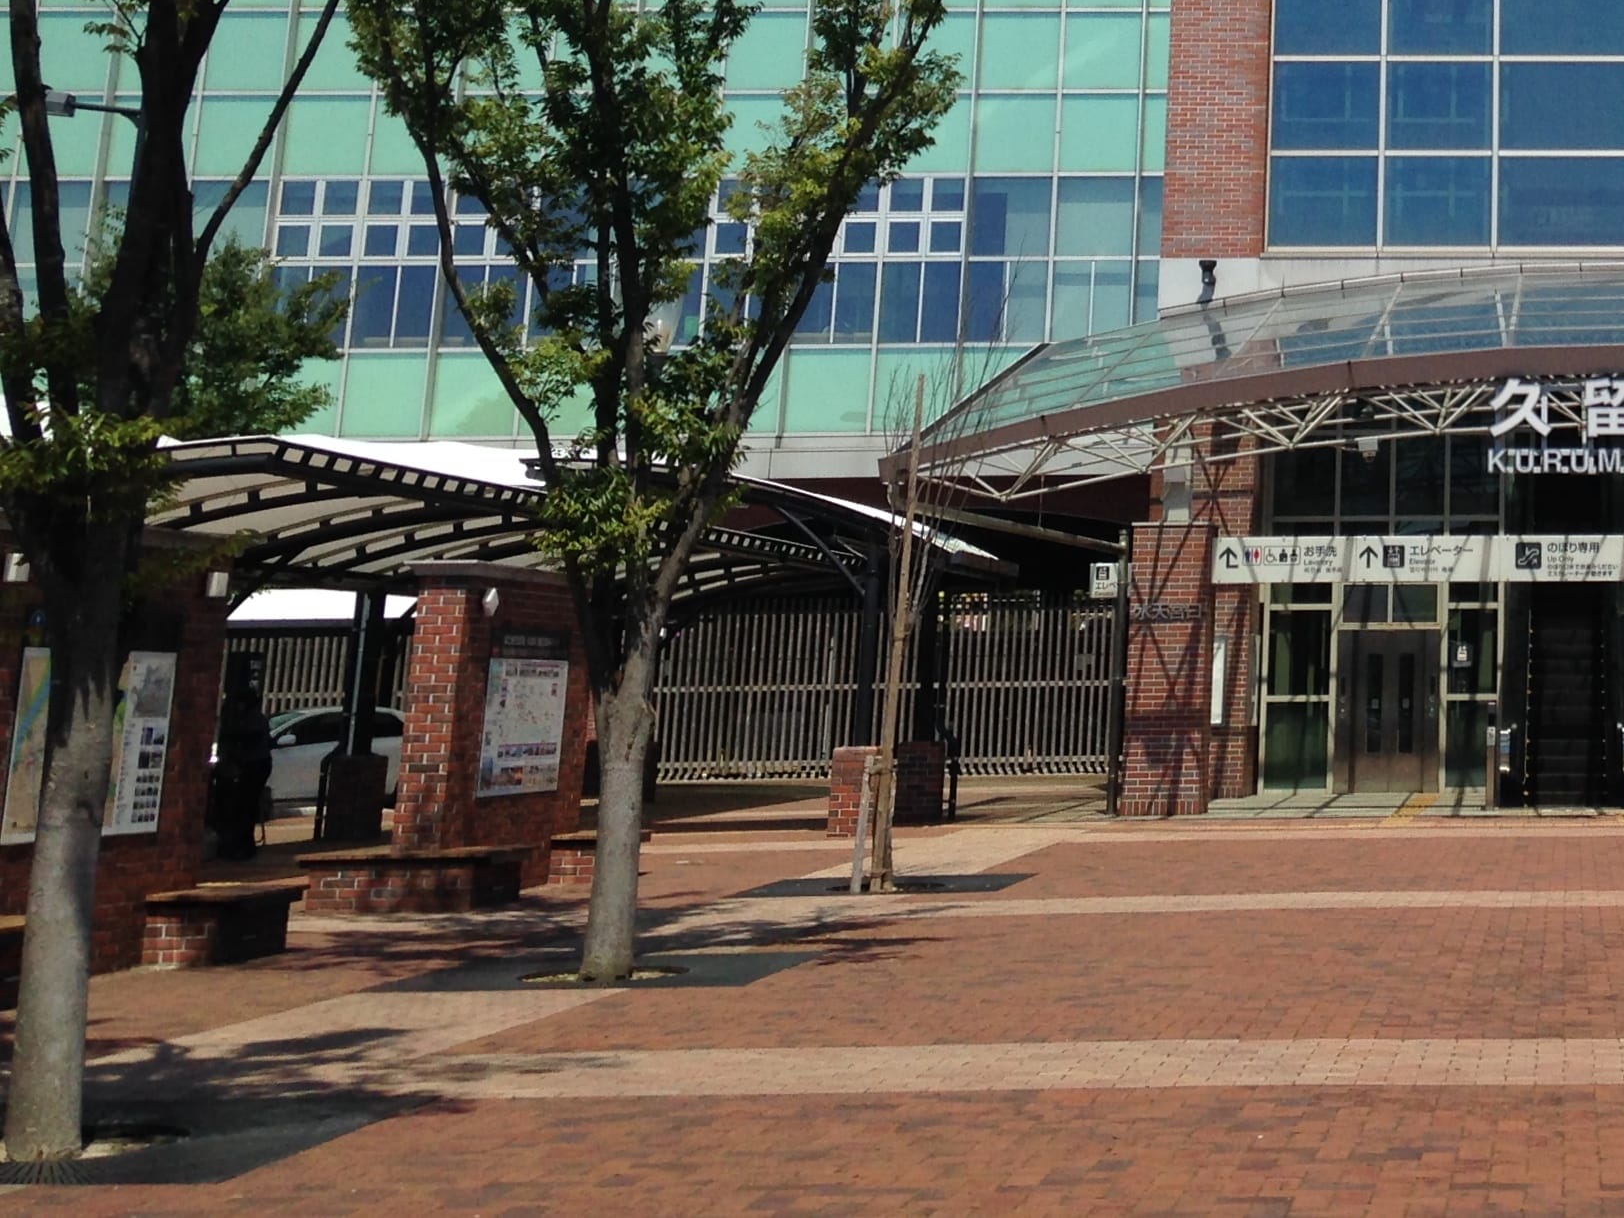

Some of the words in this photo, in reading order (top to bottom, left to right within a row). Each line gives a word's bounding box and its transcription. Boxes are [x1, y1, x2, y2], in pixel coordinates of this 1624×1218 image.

[1409, 545, 1474, 556] エレベーター
[1547, 542, 1600, 553] のぼり専用
[1547, 555, 1557, 563] Up
